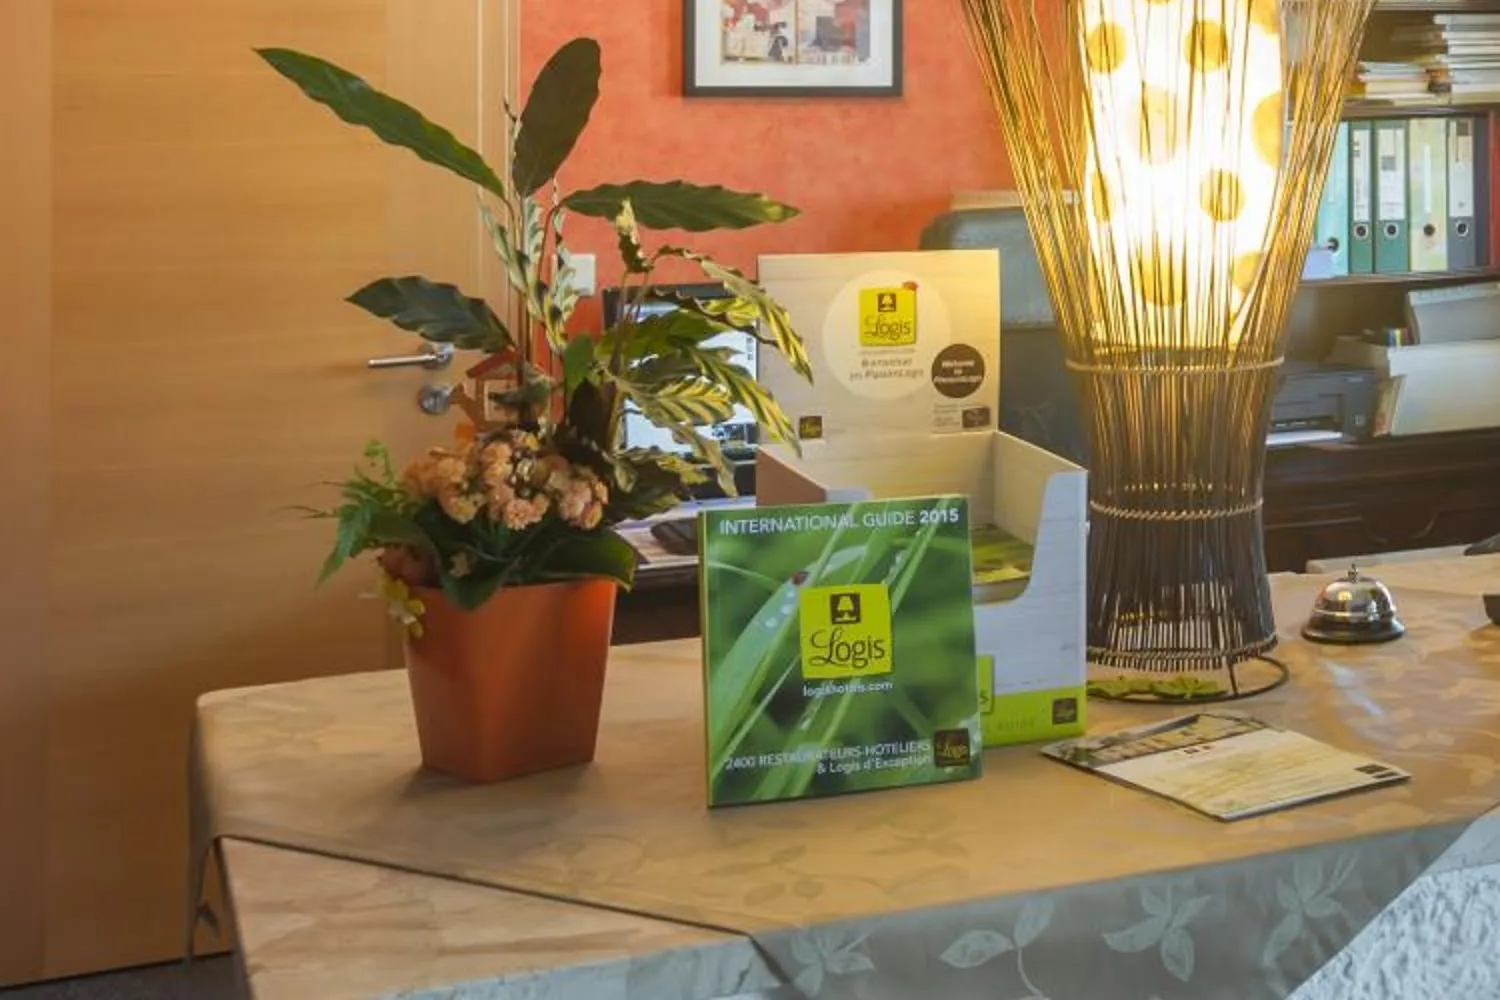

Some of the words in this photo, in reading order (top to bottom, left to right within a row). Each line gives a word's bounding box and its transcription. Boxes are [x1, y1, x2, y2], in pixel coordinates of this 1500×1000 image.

[719, 512, 859, 535] INTERNATIONAL
[862, 511, 915, 528] GUIDE
[919, 508, 959, 524] 2015
[808, 626, 886, 669] Logis
